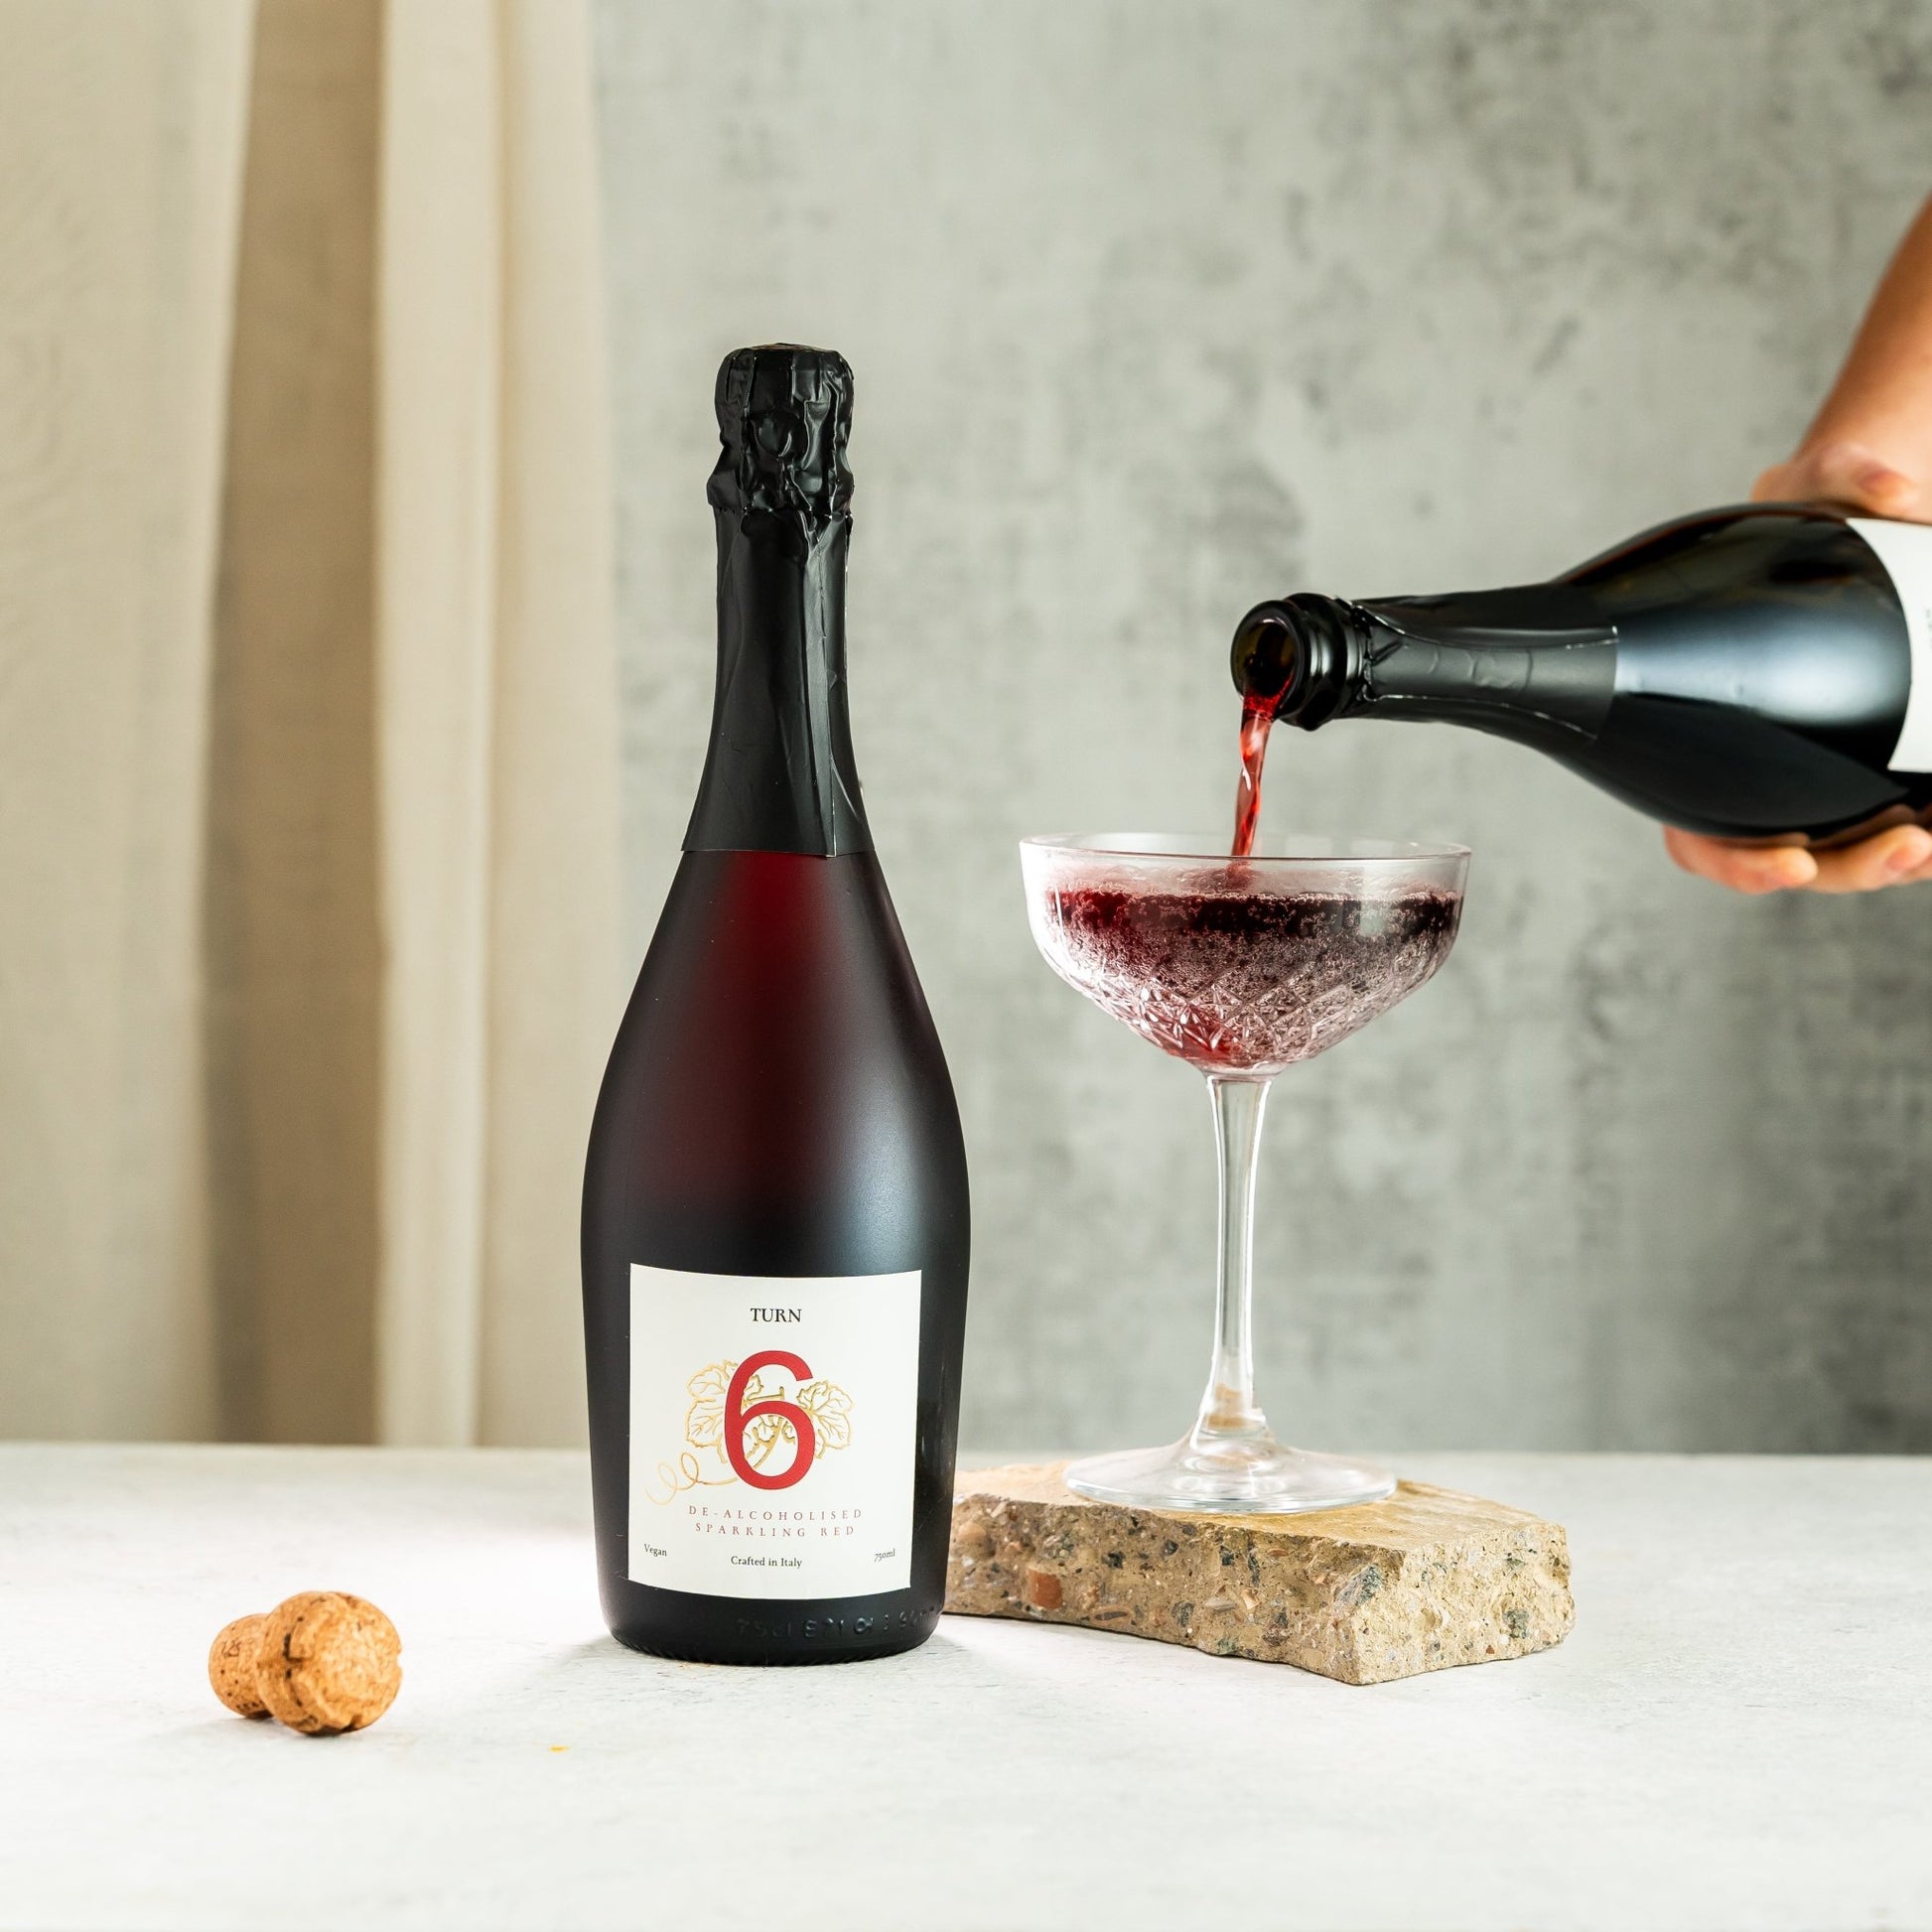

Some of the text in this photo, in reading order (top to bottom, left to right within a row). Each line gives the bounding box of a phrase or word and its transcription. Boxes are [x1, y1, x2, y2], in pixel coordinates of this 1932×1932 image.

[750, 1308, 802, 1323] TURN
[724, 1349, 815, 1491] 6
[689, 1504, 862, 1521] DE-ALCOHOLISED
[695, 1522, 855, 1538] SPARKLING RED
[643, 1543, 667, 1558] Vegan
[874, 1548, 897, 1563] 750ml
[731, 1556, 803, 1569] Crafted in Italy
